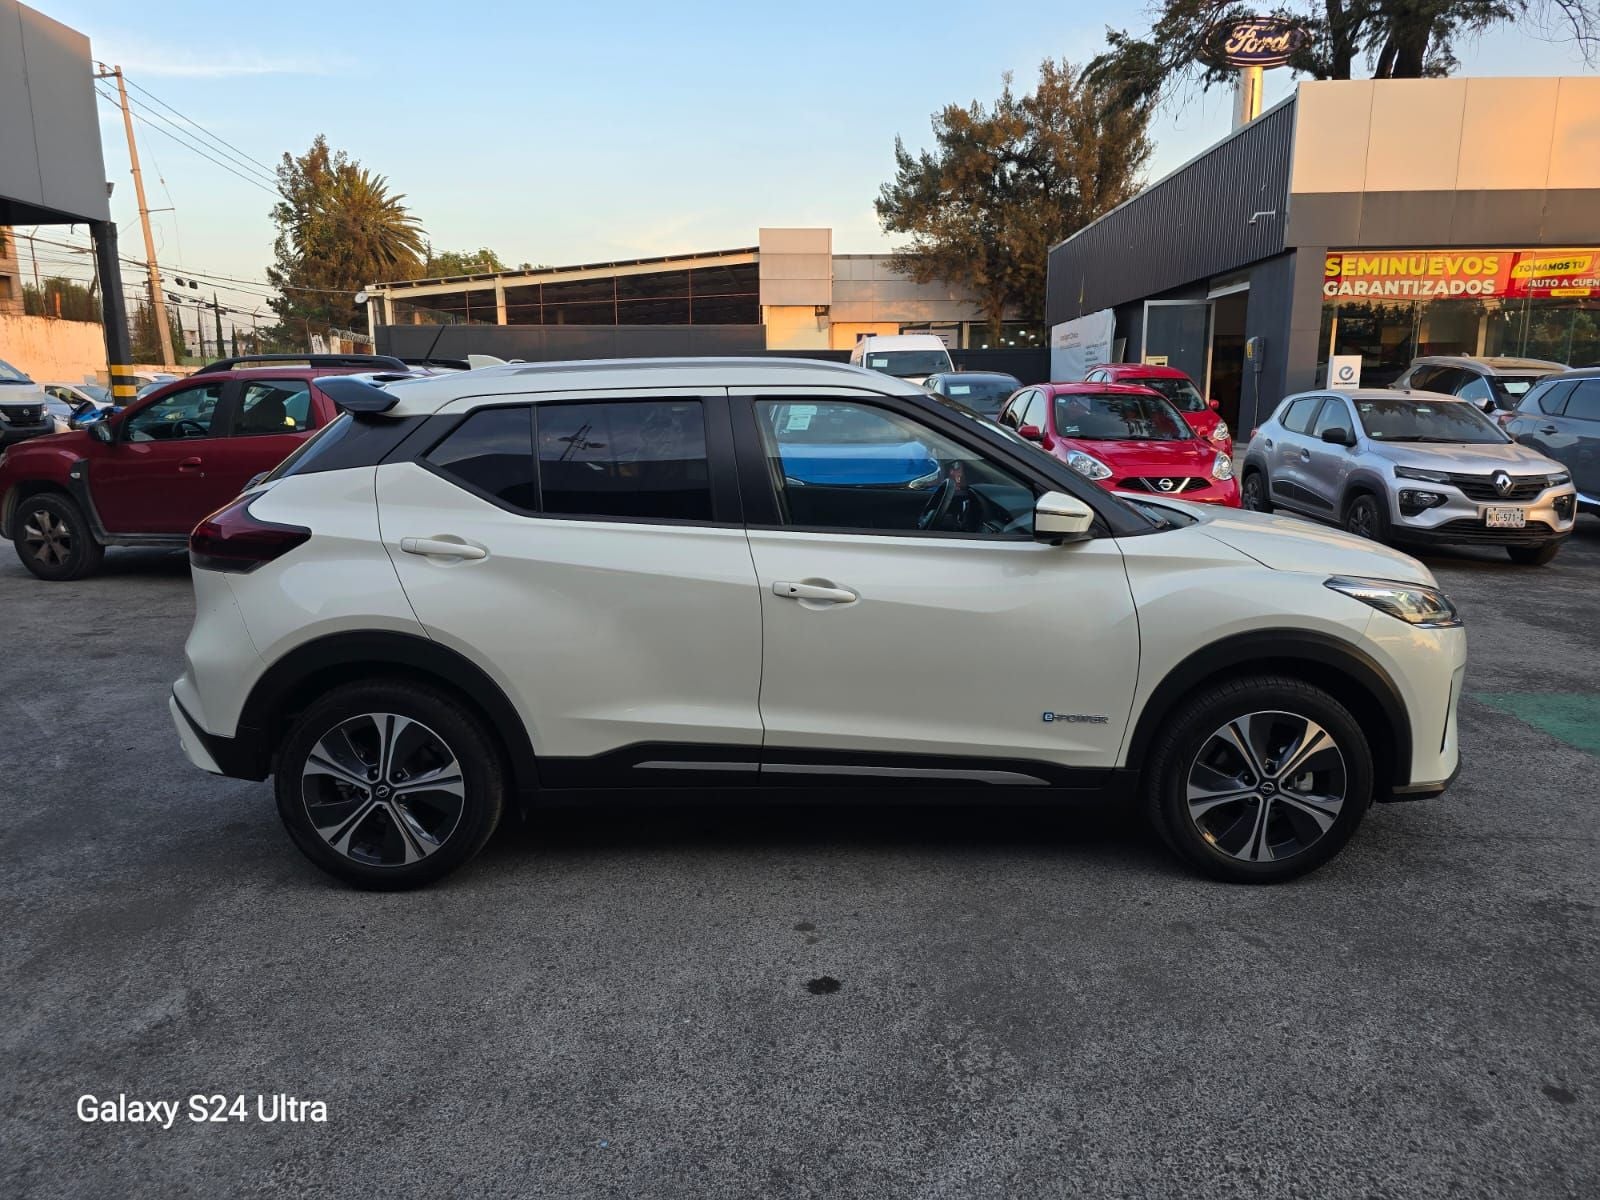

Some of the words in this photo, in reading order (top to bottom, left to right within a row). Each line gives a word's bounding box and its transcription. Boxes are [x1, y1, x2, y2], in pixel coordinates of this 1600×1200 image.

[1225, 24, 1291, 54] Ford
[1325, 255, 1499, 277] SEMINUEVOS
[1519, 261, 1570, 273] TOMAMOS
[1572, 261, 1586, 269] TU
[1323, 279, 1495, 296] GARANTIZADOS
[1528, 279, 1559, 288] AUTO
[1561, 279, 1569, 287] A
